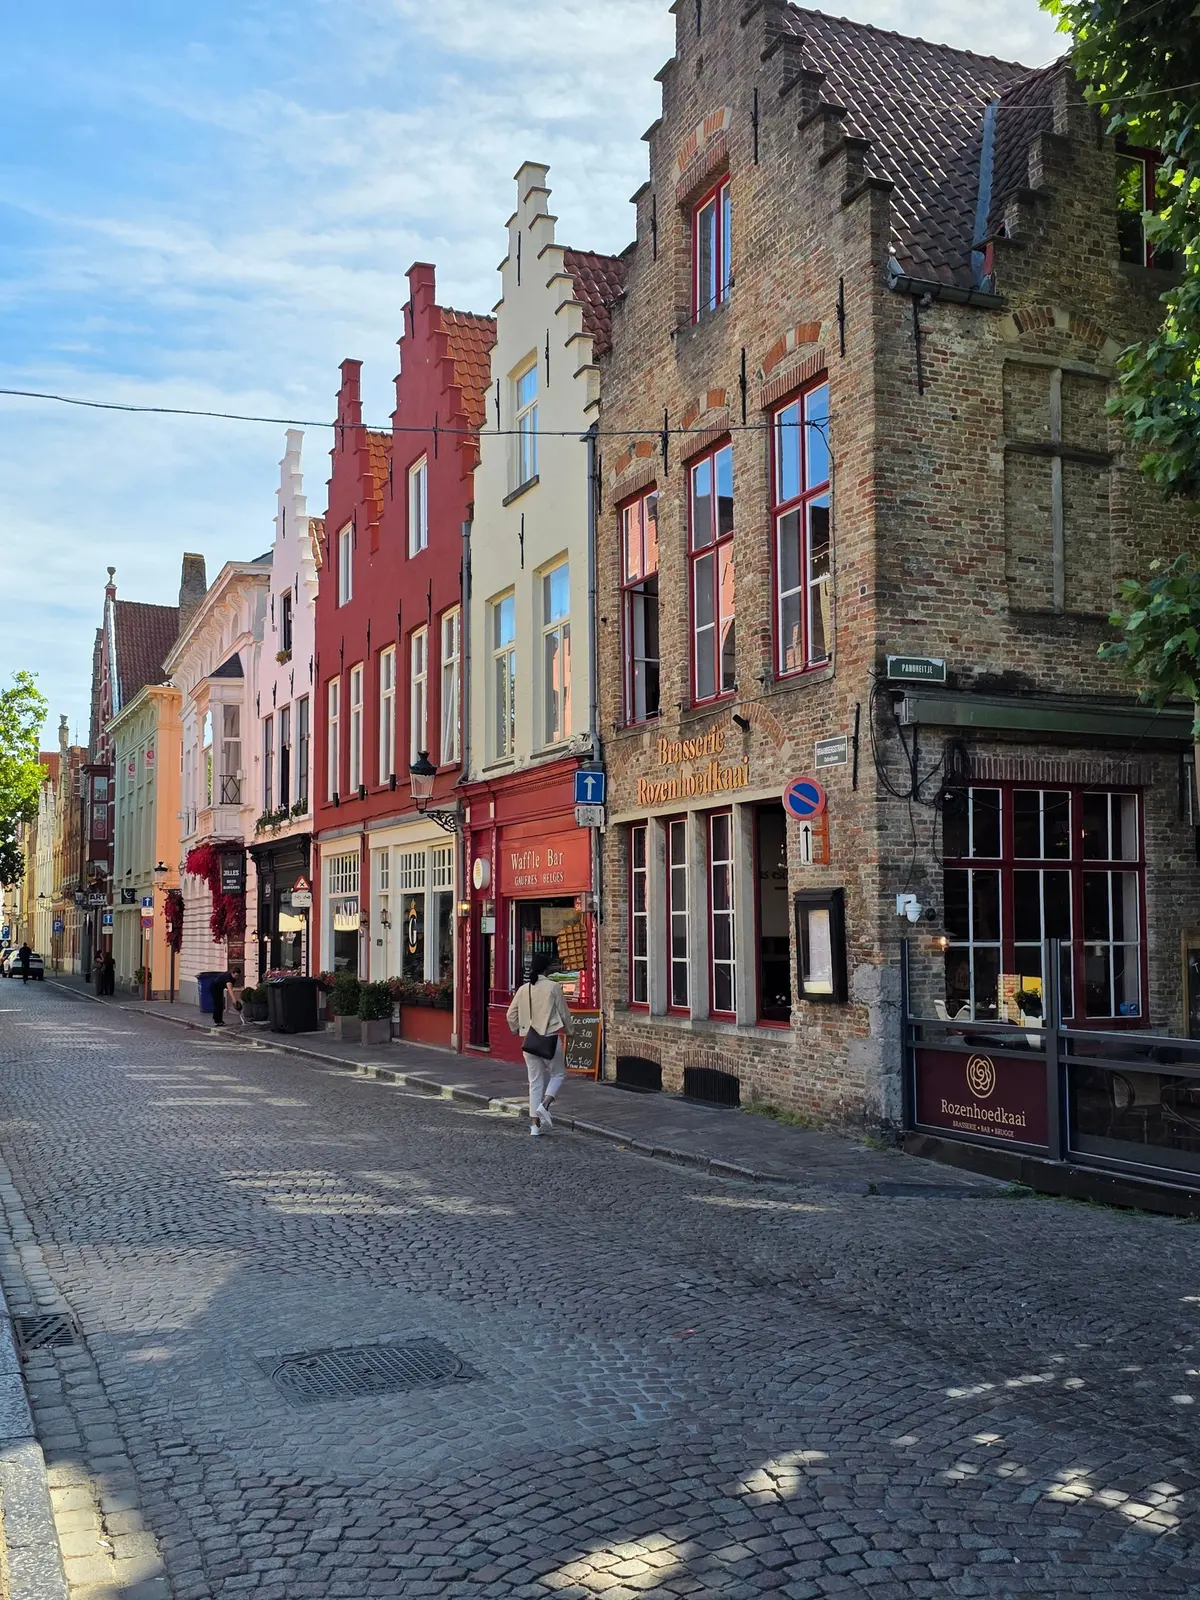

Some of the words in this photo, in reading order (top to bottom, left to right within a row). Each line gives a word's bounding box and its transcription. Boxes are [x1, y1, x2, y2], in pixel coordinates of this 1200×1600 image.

[658, 726, 726, 766] Brasserie
[637, 755, 750, 806] Rozenhoedkaai
[511, 851, 540, 870] Waffle
[548, 848, 564, 867] Bar
[515, 874, 538, 886] GAUFRES
[543, 872, 564, 884] BELGES
[941, 1099, 1026, 1127] Rozenhoedkaai
[953, 1120, 977, 1131] BRASSERIE
[981, 1125, 991, 1133] BAR
[995, 1128, 1015, 1138] BRUGGE
